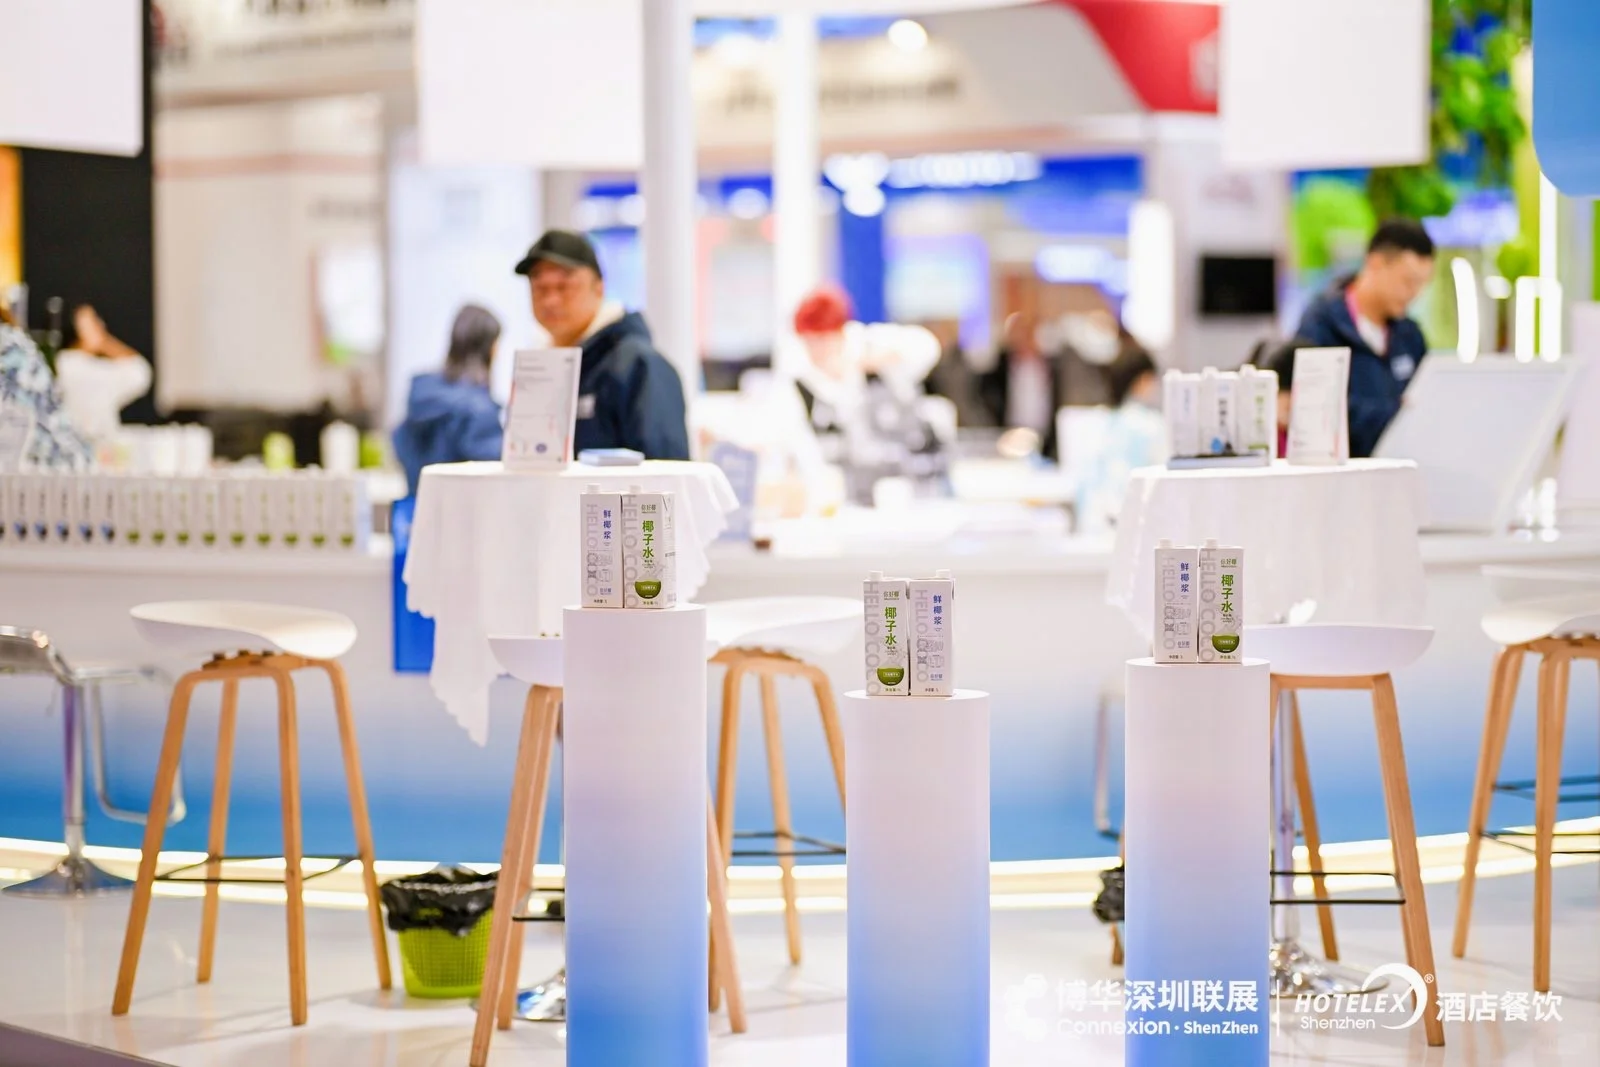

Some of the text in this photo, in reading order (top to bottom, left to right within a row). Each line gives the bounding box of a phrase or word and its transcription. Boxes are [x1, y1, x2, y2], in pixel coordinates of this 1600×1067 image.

[603, 509, 612, 540] 鲜椰浆
[642, 520, 654, 559] 椰子水
[622, 494, 639, 607] HELLO COCO
[1180, 562, 1190, 593] 鲜椰浆
[1221, 574, 1234, 613] 椰子水
[933, 595, 943, 625] 鲜椰浆
[1200, 548, 1216, 662] HELLO COCO
[864, 581, 881, 696] HELLO COCO
[884, 606, 897, 645] 椰子水
